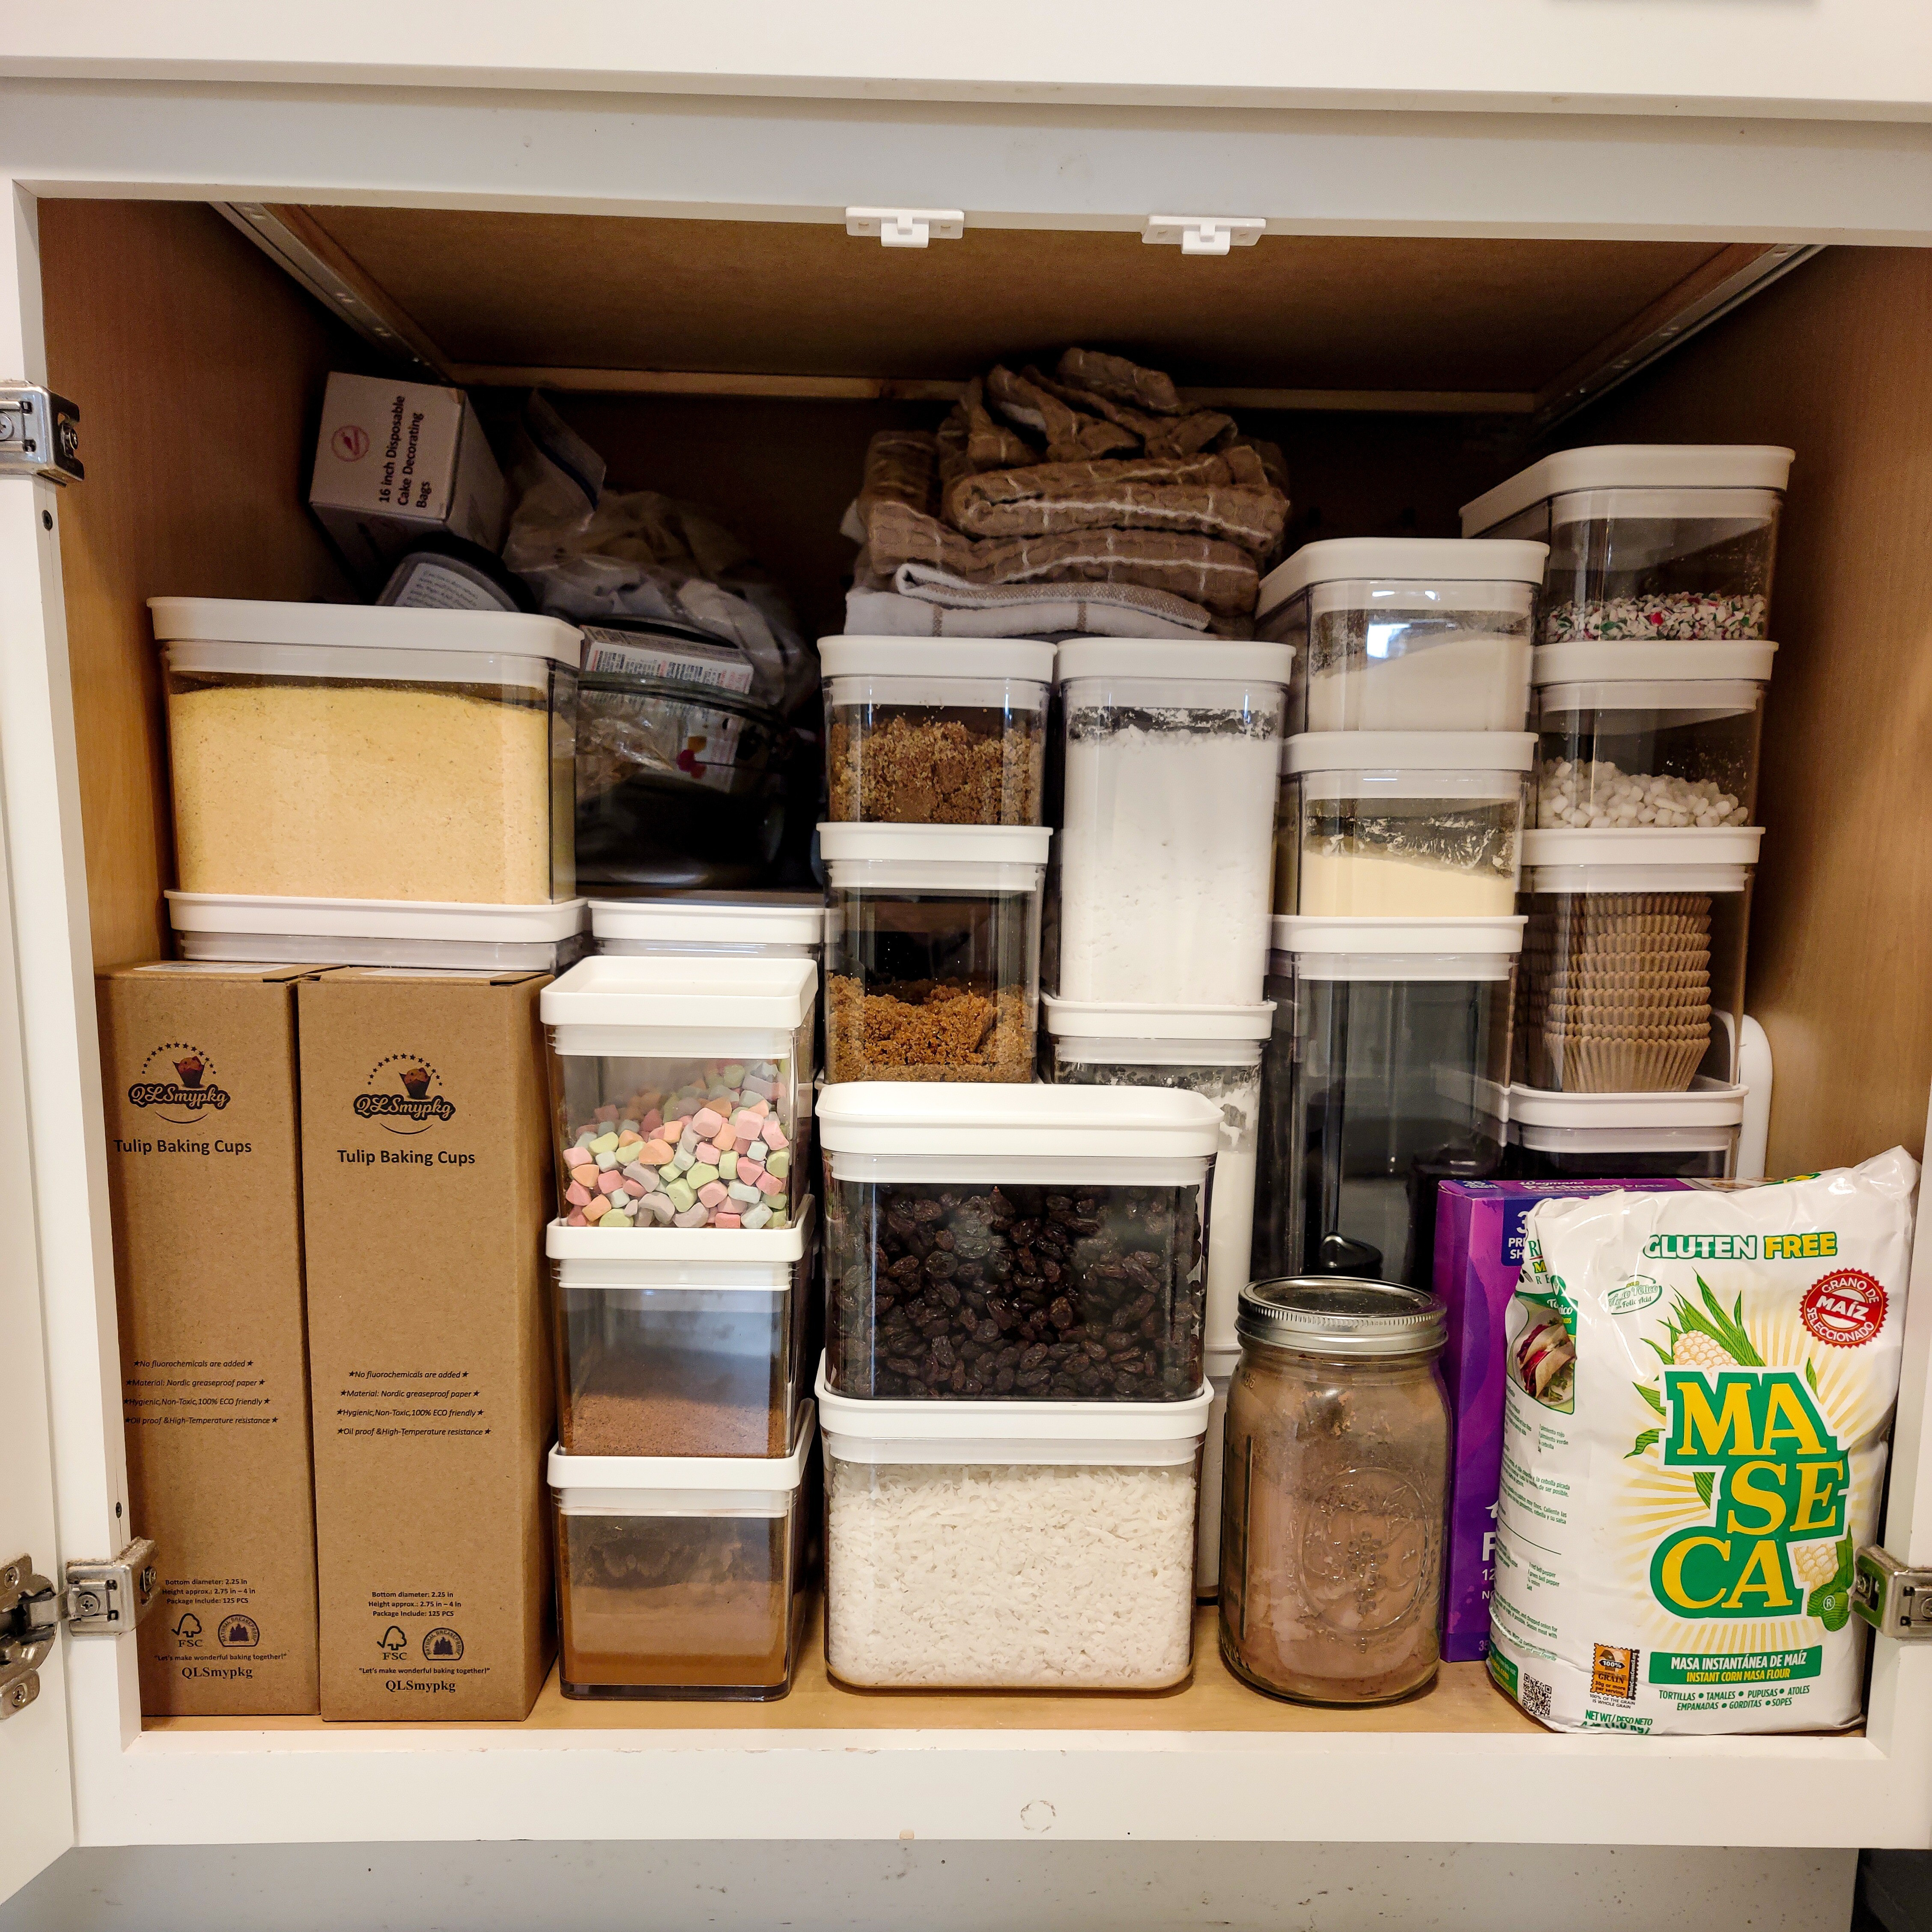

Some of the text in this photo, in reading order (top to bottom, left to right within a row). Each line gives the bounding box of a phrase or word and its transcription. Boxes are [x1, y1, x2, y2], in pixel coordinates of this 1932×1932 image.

[379, 396, 405, 502] 16 inch Disposable
[398, 413, 424, 505] Cake Decorating
[416, 481, 432, 508] Bags
[113, 1139, 252, 1155] Tulip Baking Cups
[337, 1150, 475, 1167] Tulip Baking Cups
[1643, 1231, 1837, 1259] GLUTEN FREE
[1822, 1277, 1879, 1303] GRANO DE
[1638, 1296, 1652, 1304] Acid
[1816, 1295, 1869, 1321] MAÍZ
[1807, 1307, 1874, 1342] SELECCIONADO
[192, 1379, 235, 1387] greaseproof
[366, 1371, 423, 1379] fluorochemicals
[1677, 1382, 1827, 1455] MA
[355, 1428, 375, 1436] proof
[1726, 1460, 1843, 1535] SE
[1661, 1535, 1793, 1609] CA
[382, 1652, 407, 1661] FSC
[1671, 1650, 1807, 1670] MASA INSTANTÁNEA DE MAÍZ
[182, 1667, 253, 1679] QLSmypkg
[1598, 1673, 1625, 1684] GRAIN
[1686, 1668, 1790, 1682] INSTANT CORN MASA FLOUR
[385, 1680, 456, 1693] QLSmypkg
[1659, 1685, 1810, 1701] TORTILLAS TAMALES PUPUSAS ATOLES
[1677, 1698, 1792, 1711] EMPANADAS GORDITAS SOPES
[1585, 1709, 1599, 1721] NET
